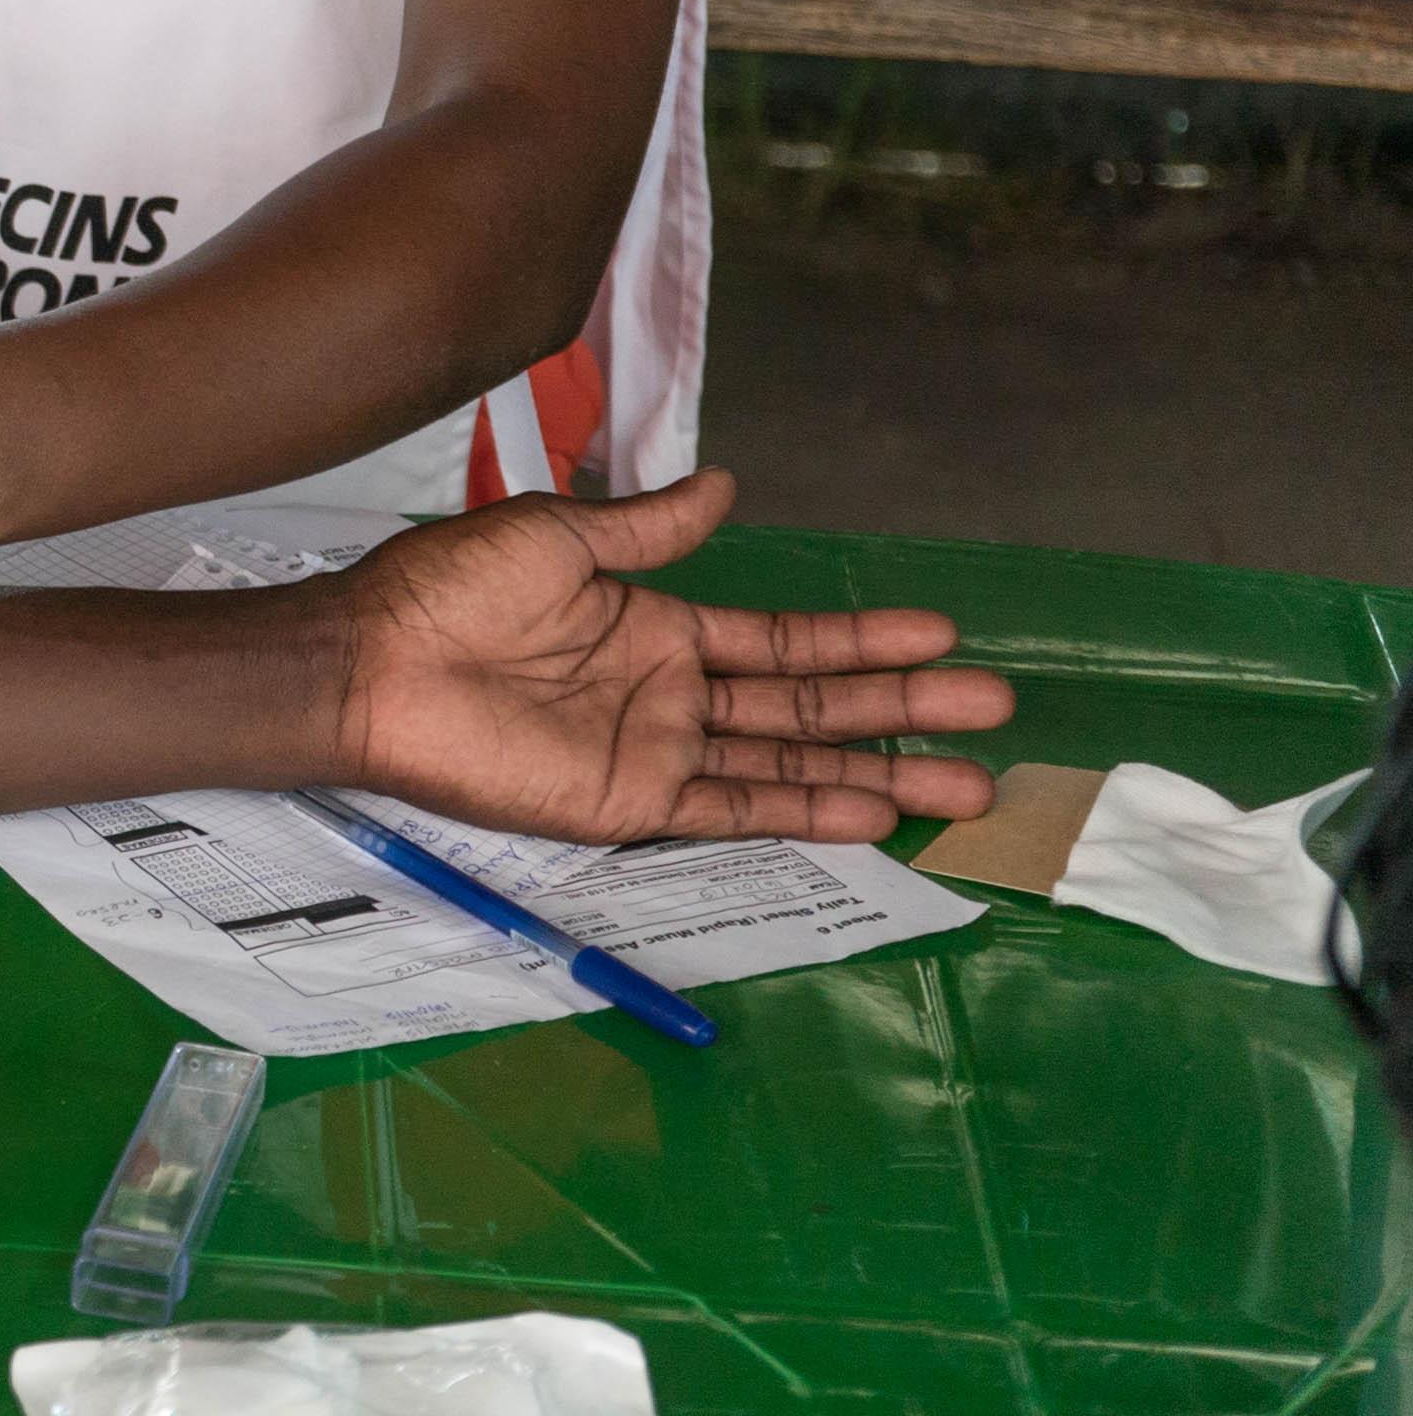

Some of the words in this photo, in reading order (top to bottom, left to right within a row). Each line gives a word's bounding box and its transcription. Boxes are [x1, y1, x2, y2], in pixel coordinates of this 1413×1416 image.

[816, 896, 866, 911] Tally
[759, 907, 815, 923] Sheet
[833, 911, 888, 930] Sheet
[697, 915, 758, 934] (Rapid
[816, 926, 832, 935] 6
[642, 929, 696, 945] Muac
